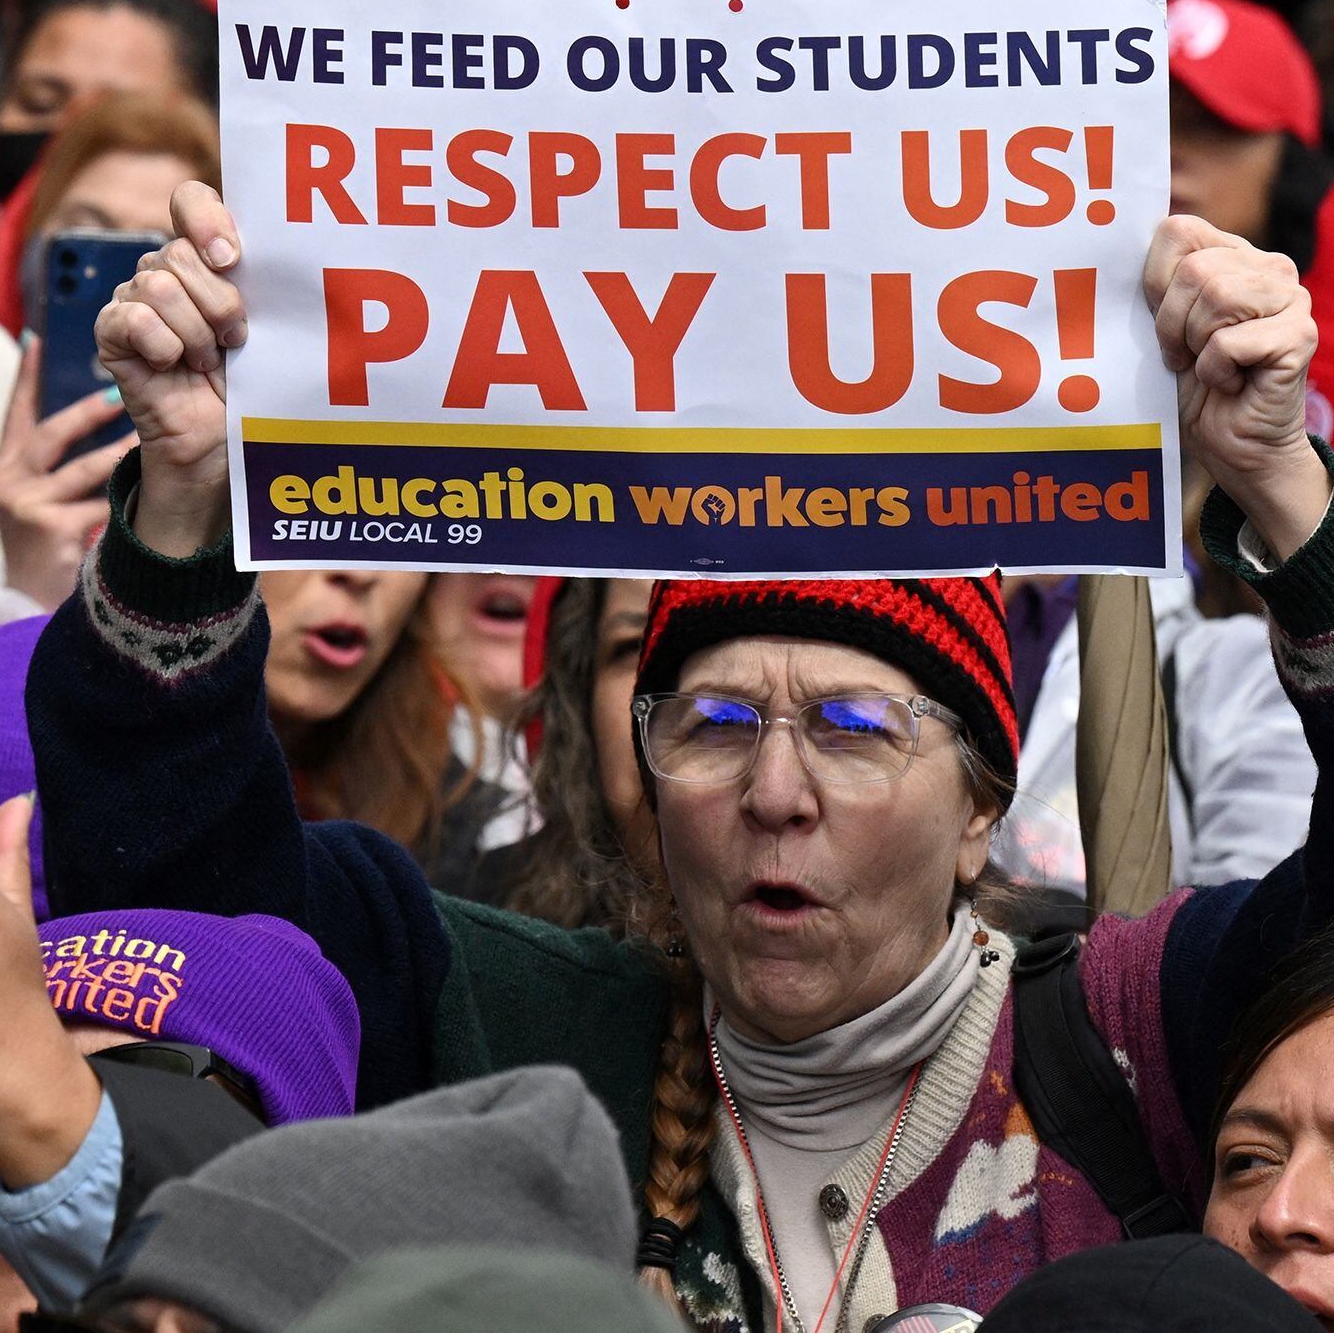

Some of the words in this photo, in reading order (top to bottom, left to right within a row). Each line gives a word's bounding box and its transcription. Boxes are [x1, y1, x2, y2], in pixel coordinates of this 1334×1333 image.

[235, 24, 344, 84] WE
[372, 31, 539, 89] FEED
[567, 36, 734, 92] OUR
[757, 28, 1154, 92] STUDENTS
[286, 124, 851, 230] RESPECT
[902, 126, 1115, 229] US!
[323, 268, 715, 411] PAY
[786, 268, 1099, 414] US!
[270, 466, 614, 522] education
[629, 476, 910, 526] workers
[927, 472, 1148, 525] united
[272, 520, 342, 541] SEIU
[350, 522, 437, 543] LOCAL
[448, 524, 482, 544] 99
[46, 976, 177, 1034] nited
